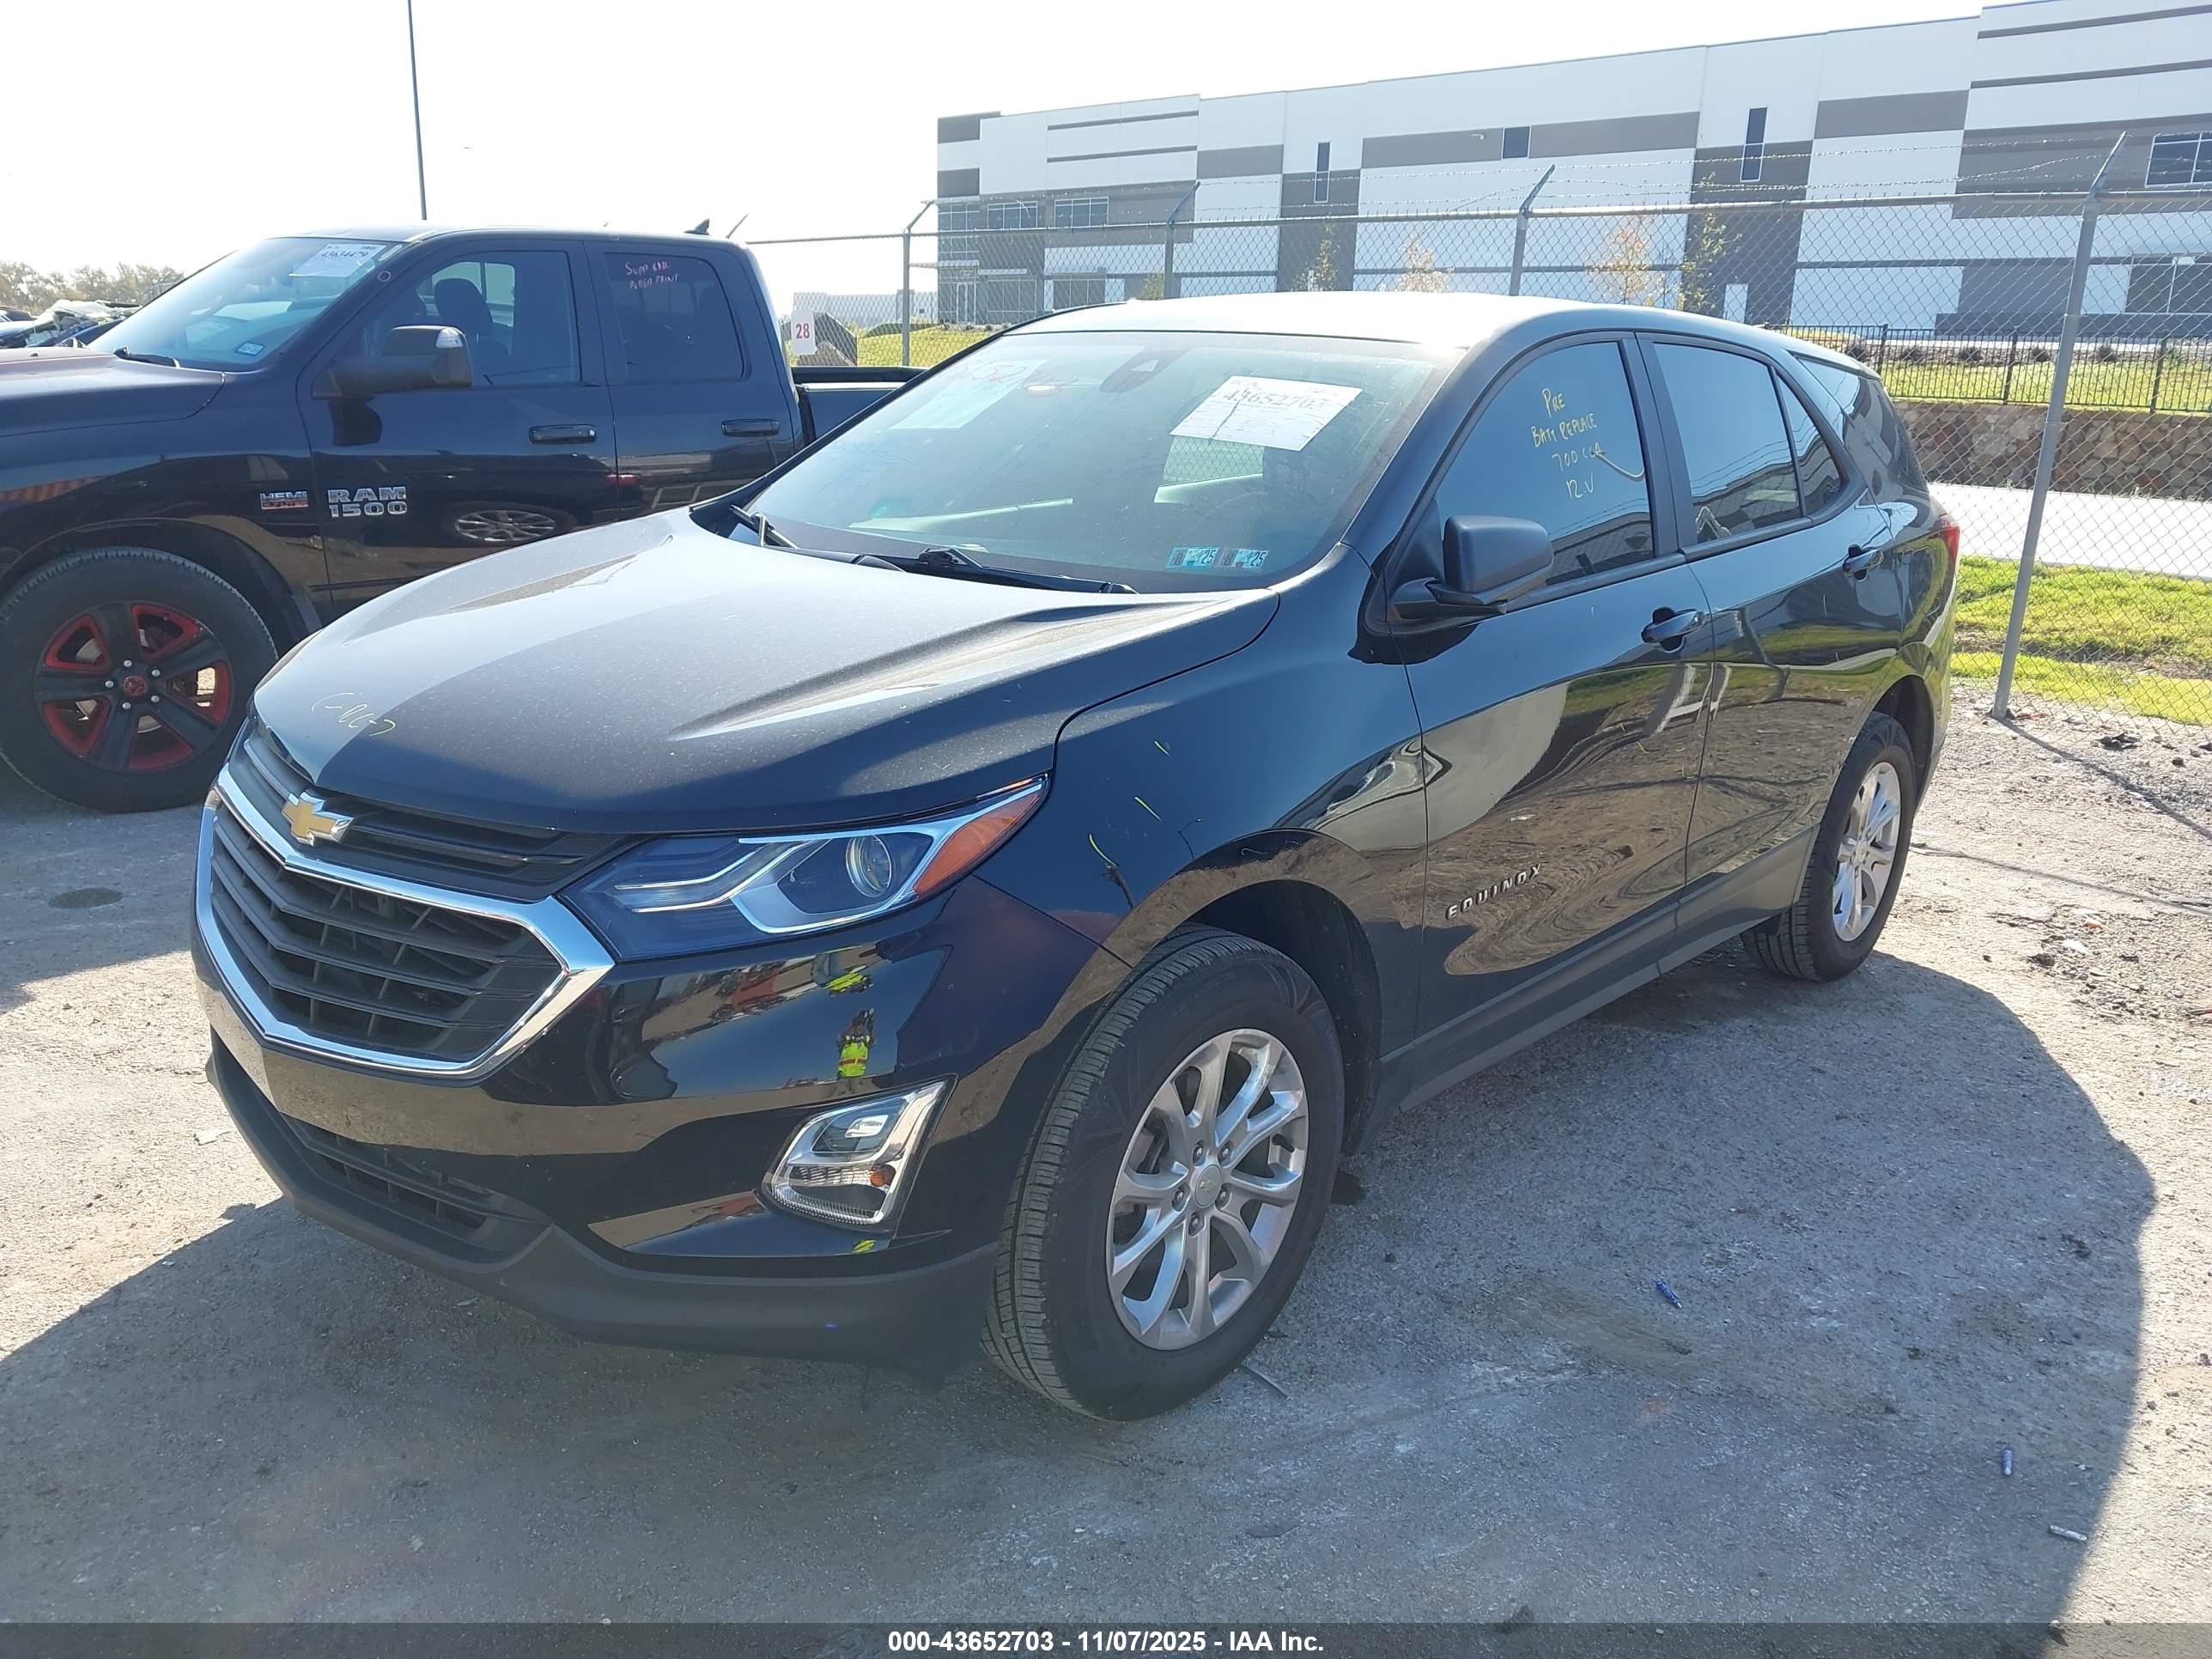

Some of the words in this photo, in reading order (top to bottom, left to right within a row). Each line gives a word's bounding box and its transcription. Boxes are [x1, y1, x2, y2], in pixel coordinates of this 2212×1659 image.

[795, 323, 811, 339] 28
[1541, 387, 1566, 418] PRE
[1559, 412, 1597, 441] REPLACE
[1552, 449, 1578, 472] 700
[260, 490, 307, 502] HEMI
[327, 486, 406, 503] RAM
[329, 501, 408, 518] 1500
[1201, 549, 1217, 564] 25
[1250, 550, 1267, 567] 25
[1445, 863, 1541, 921] EQUINOX
